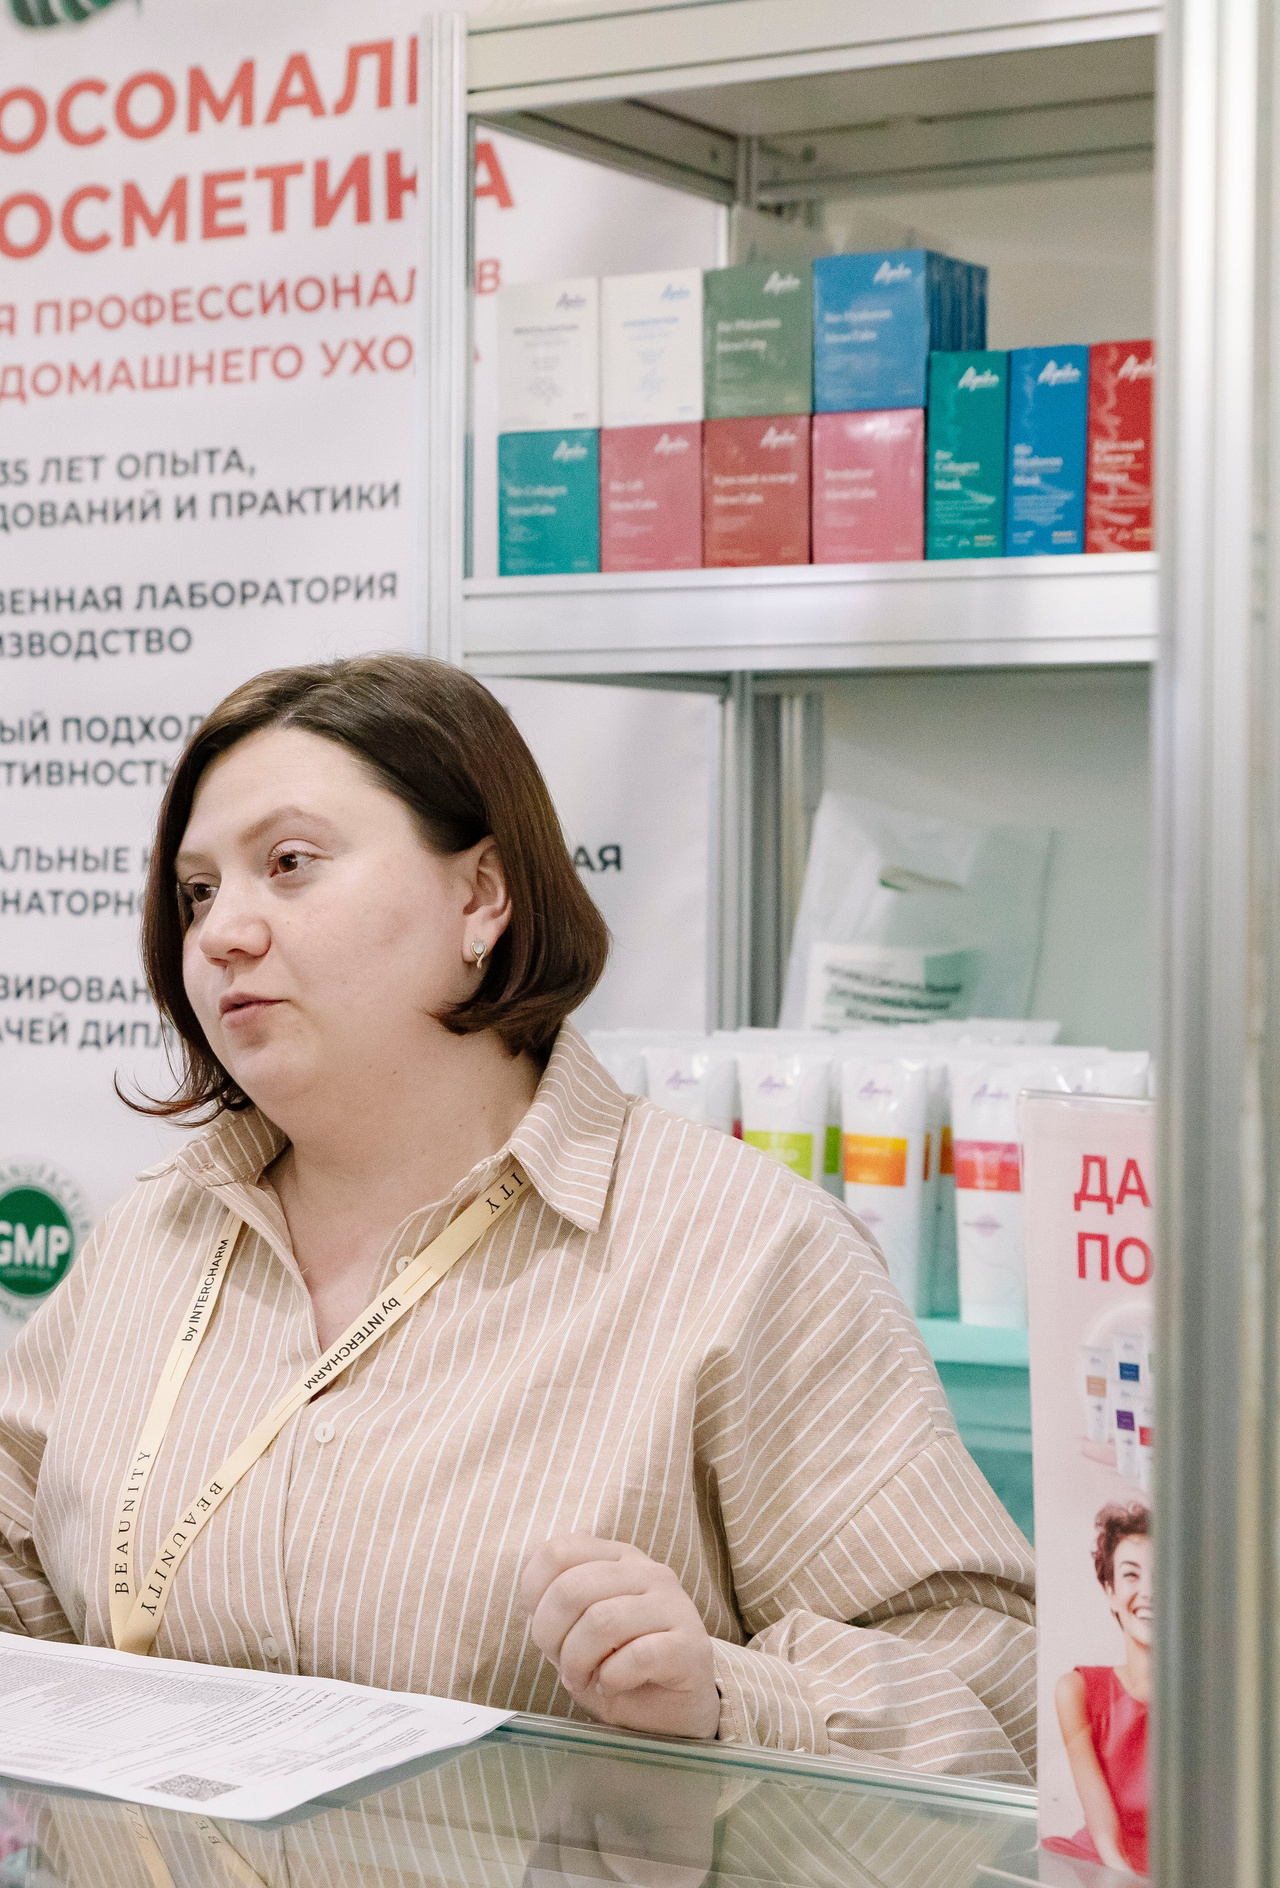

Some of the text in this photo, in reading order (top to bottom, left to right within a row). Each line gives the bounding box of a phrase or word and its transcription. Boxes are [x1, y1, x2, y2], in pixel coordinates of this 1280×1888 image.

[320, 335, 417, 378] УХО
[40, 454, 106, 485] ЛЕТ
[119, 446, 256, 481] ОПЫТА,
[175, 494, 198, 521] И
[209, 481, 402, 520] ПРАКТИКИ
[135, 571, 399, 612] ЛАБОРАТОРИЯ
[181, 1238, 229, 1343] by INTERCHARM
[303, 1295, 402, 1391] by INTERCHARM
[114, 1450, 151, 1595] BEAUNITY
[140, 1481, 224, 1617] BEAUNITY
